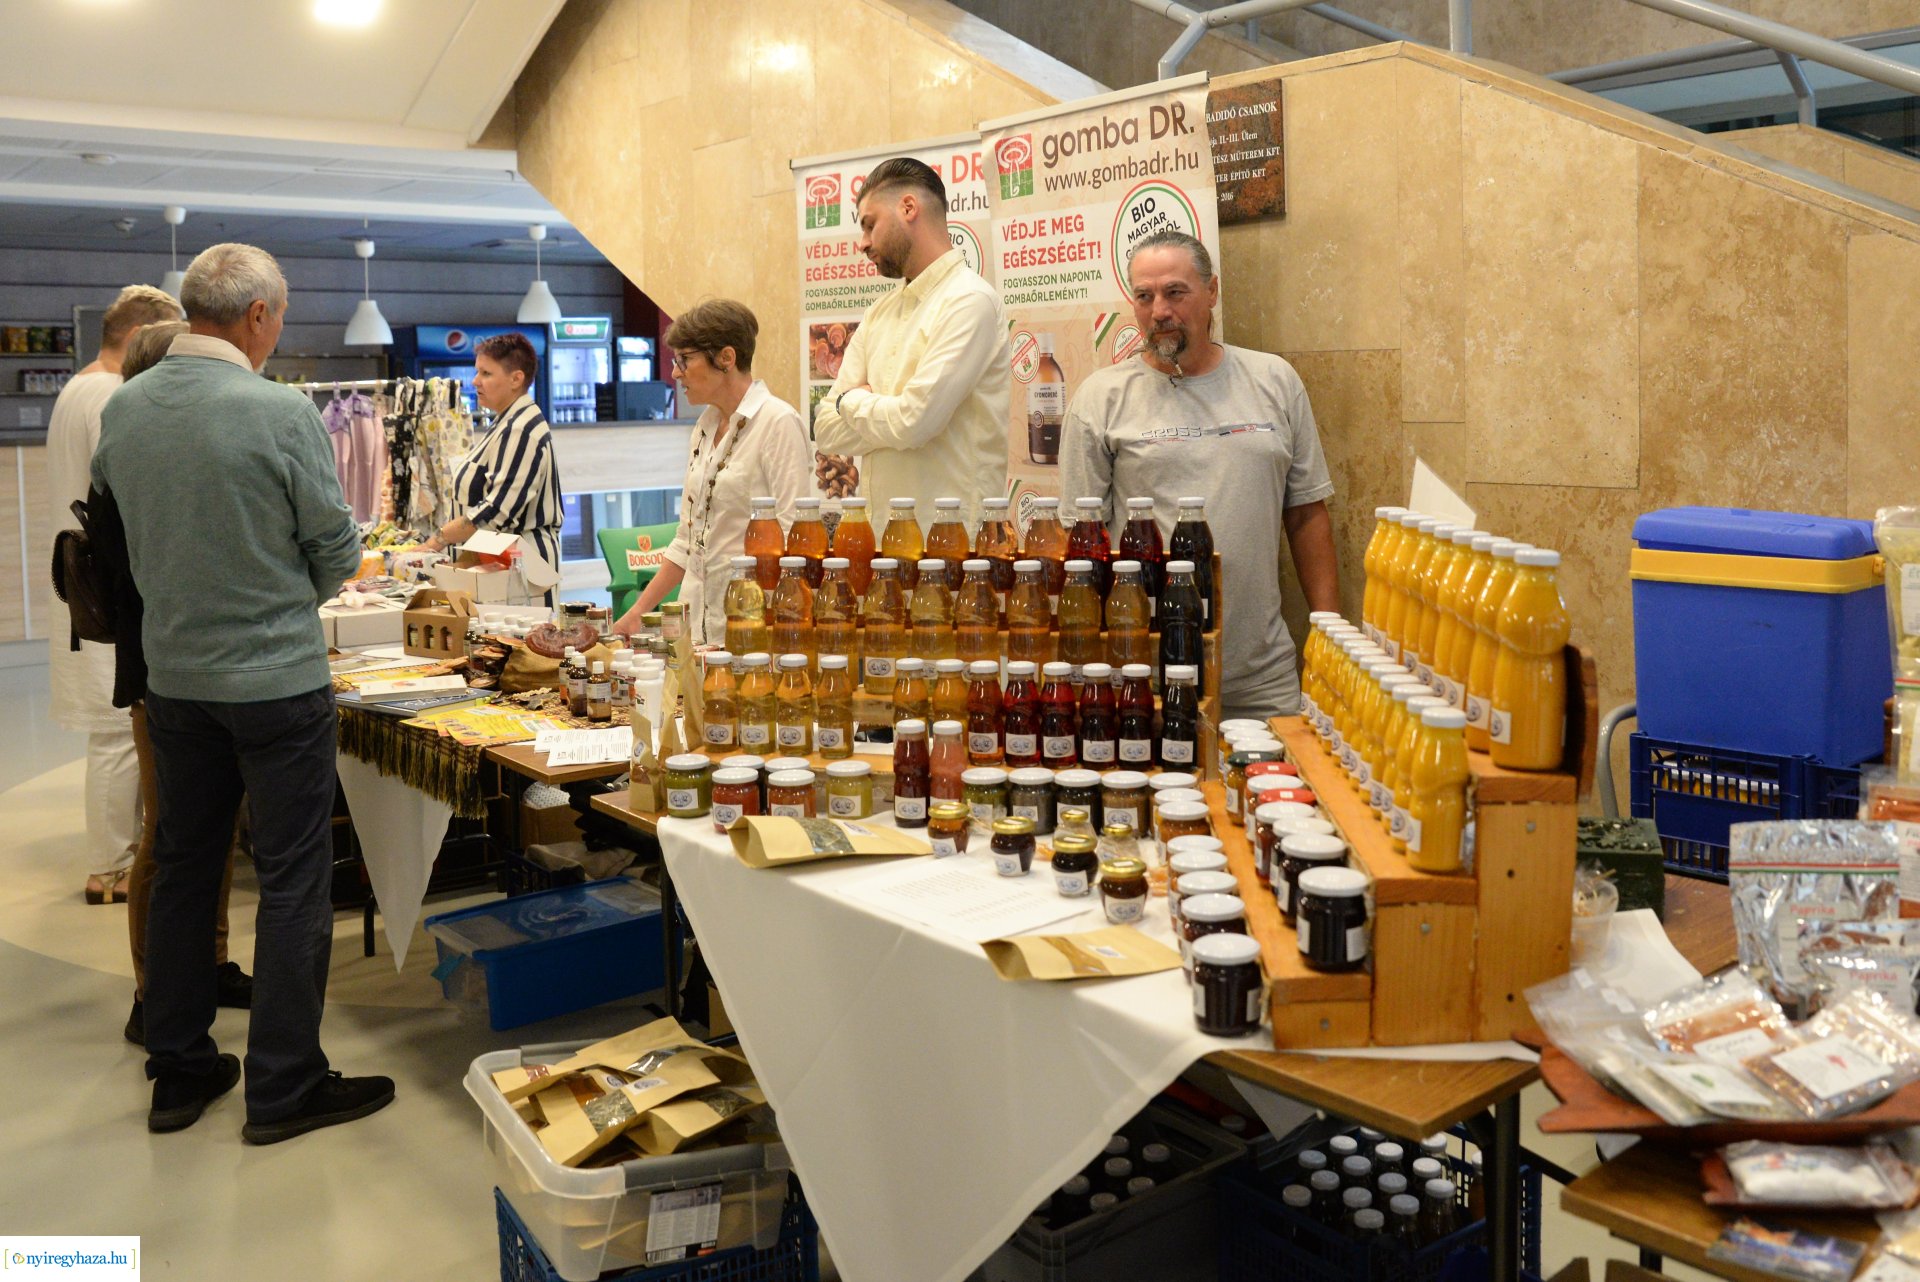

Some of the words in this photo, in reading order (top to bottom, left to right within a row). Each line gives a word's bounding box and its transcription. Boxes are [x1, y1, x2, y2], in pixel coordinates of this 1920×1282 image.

[1238, 101, 1278, 118] CSARNOK
[1041, 114, 1140, 169] gomba
[1149, 101, 1195, 142] DR.
[1266, 146, 1281, 157] KFT
[1044, 147, 1199, 193] www.gombadr.hu
[1252, 167, 1266, 178] KFT
[1131, 197, 1156, 224] BIO
[1002, 215, 1047, 243] VÉDJE
[1051, 214, 1085, 236] MEG
[1127, 211, 1167, 244] MAGYAR
[805, 241, 848, 260] VÉDJE
[1003, 237, 1102, 270] EGÉSZSÉGÉT!
[805, 259, 881, 282] EGÉSZSÉG
[1003, 273, 1059, 290] FOGYASSZON
[1059, 270, 1103, 285] NAPONTA
[805, 286, 857, 298] FOGYASSZON
[1004, 288, 1089, 306] GOMBAŐRLEMÉNYT!
[629, 552, 663, 567] BORSOD
